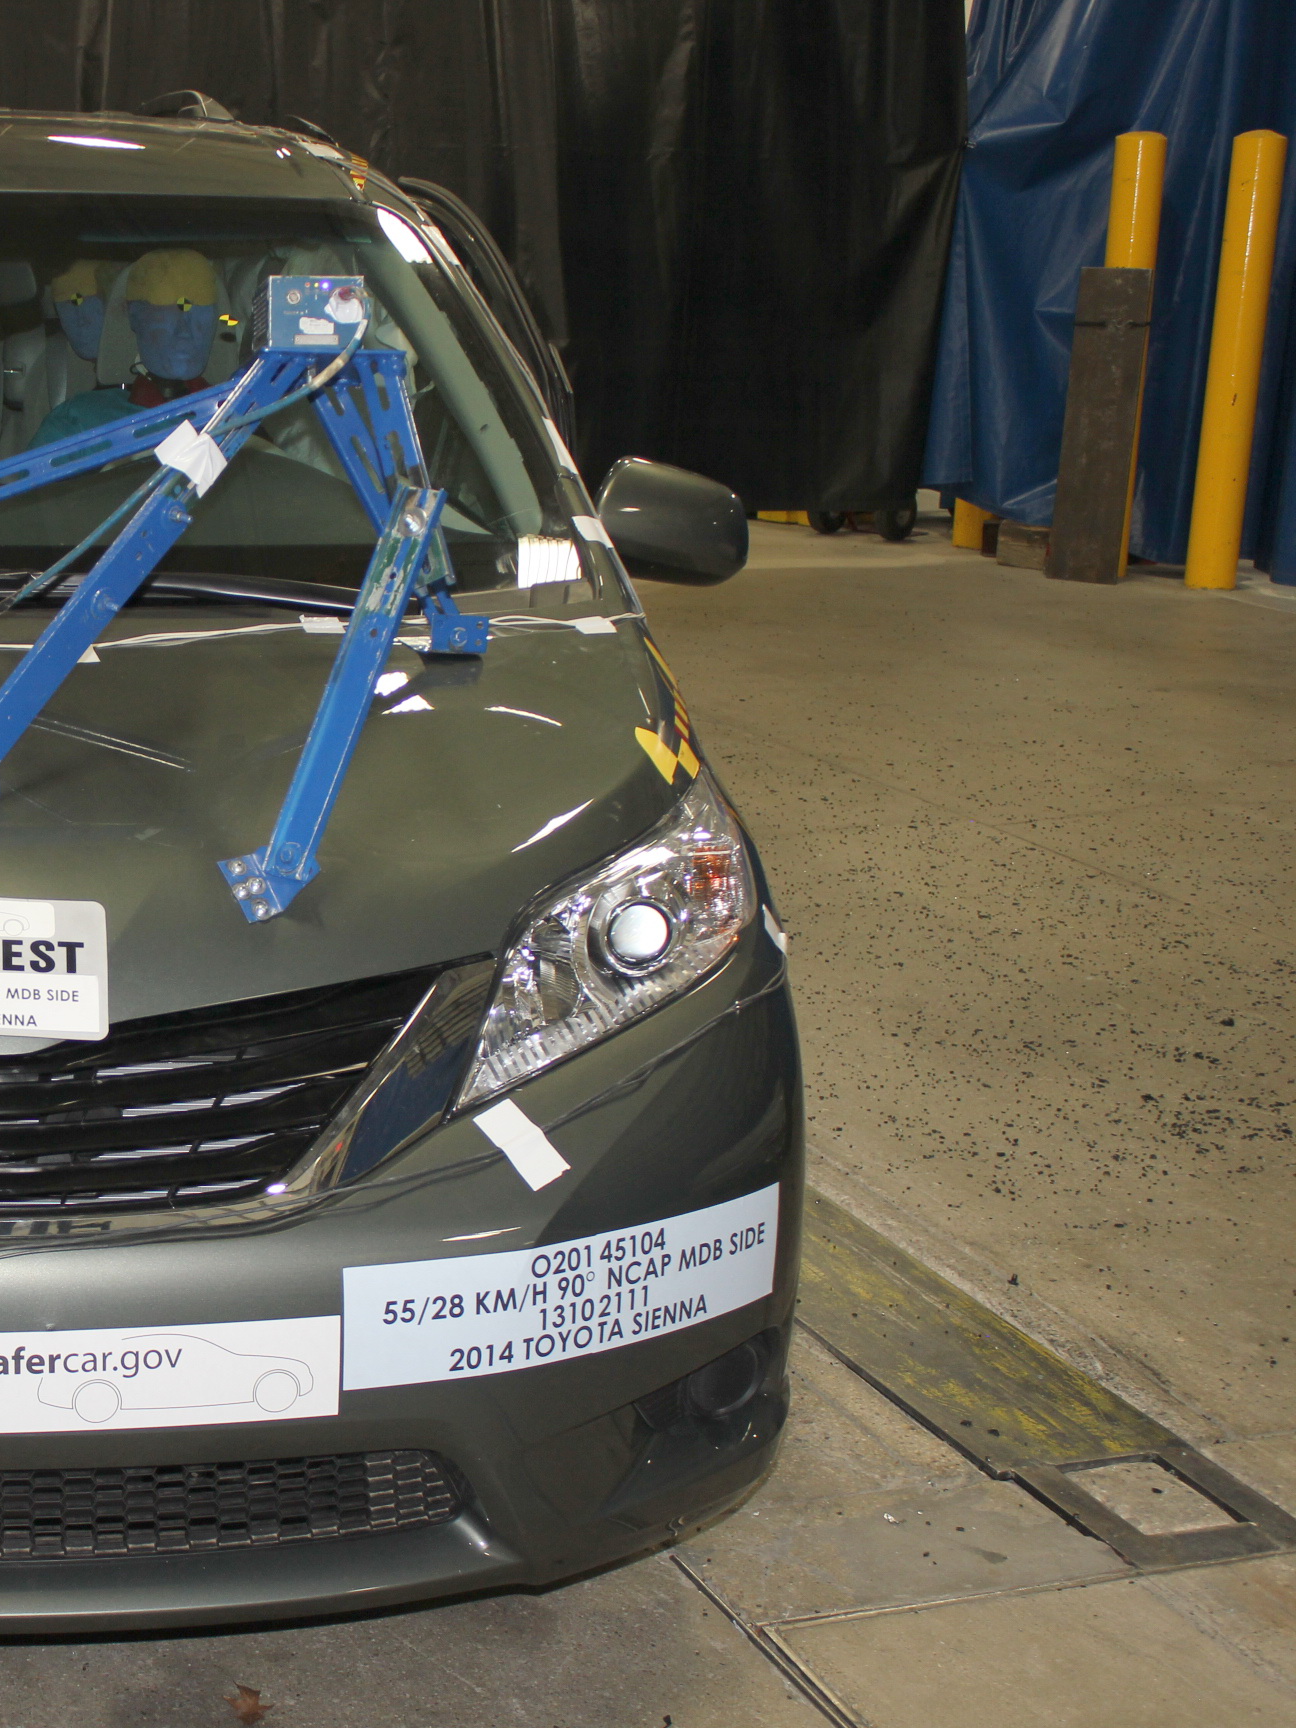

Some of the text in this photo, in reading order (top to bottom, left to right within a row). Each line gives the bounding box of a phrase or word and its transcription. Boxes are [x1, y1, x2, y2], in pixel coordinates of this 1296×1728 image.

[6, 989, 41, 1000] MDB
[47, 990, 79, 1002] SIDE
[383, 1294, 465, 1326] 55/28
[476, 1282, 547, 1316] KM/H
[608, 1254, 671, 1290] NCAP
[678, 1238, 723, 1273] MDB
[729, 1222, 765, 1255] SIDE
[449, 1294, 707, 1372] 2014 TOYOTA SIENNA
[539, 1286, 649, 1330] 13102111
